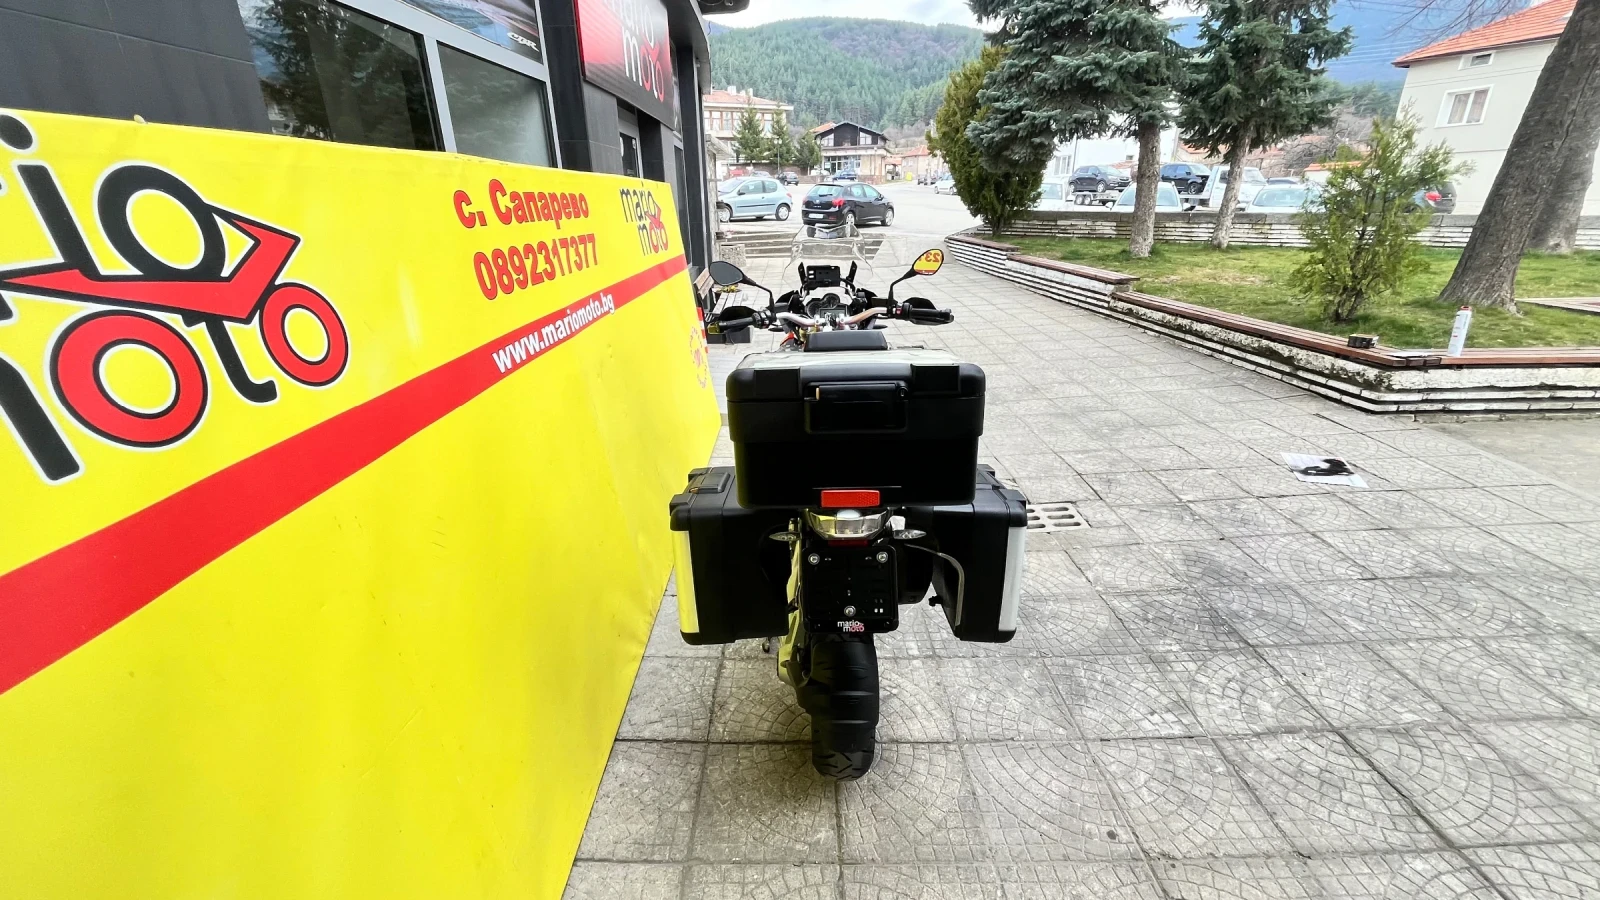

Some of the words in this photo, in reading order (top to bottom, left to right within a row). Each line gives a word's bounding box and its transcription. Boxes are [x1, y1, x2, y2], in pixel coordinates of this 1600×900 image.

[620, 26, 665, 102] moto
[488, 178, 589, 229] Сапарево
[619, 181, 657, 222] mario
[637, 221, 669, 256] moto
[473, 233, 598, 300] 0892317377
[491, 291, 615, 373] www.mariomoto.bg
[837, 619, 860, 628] mario
